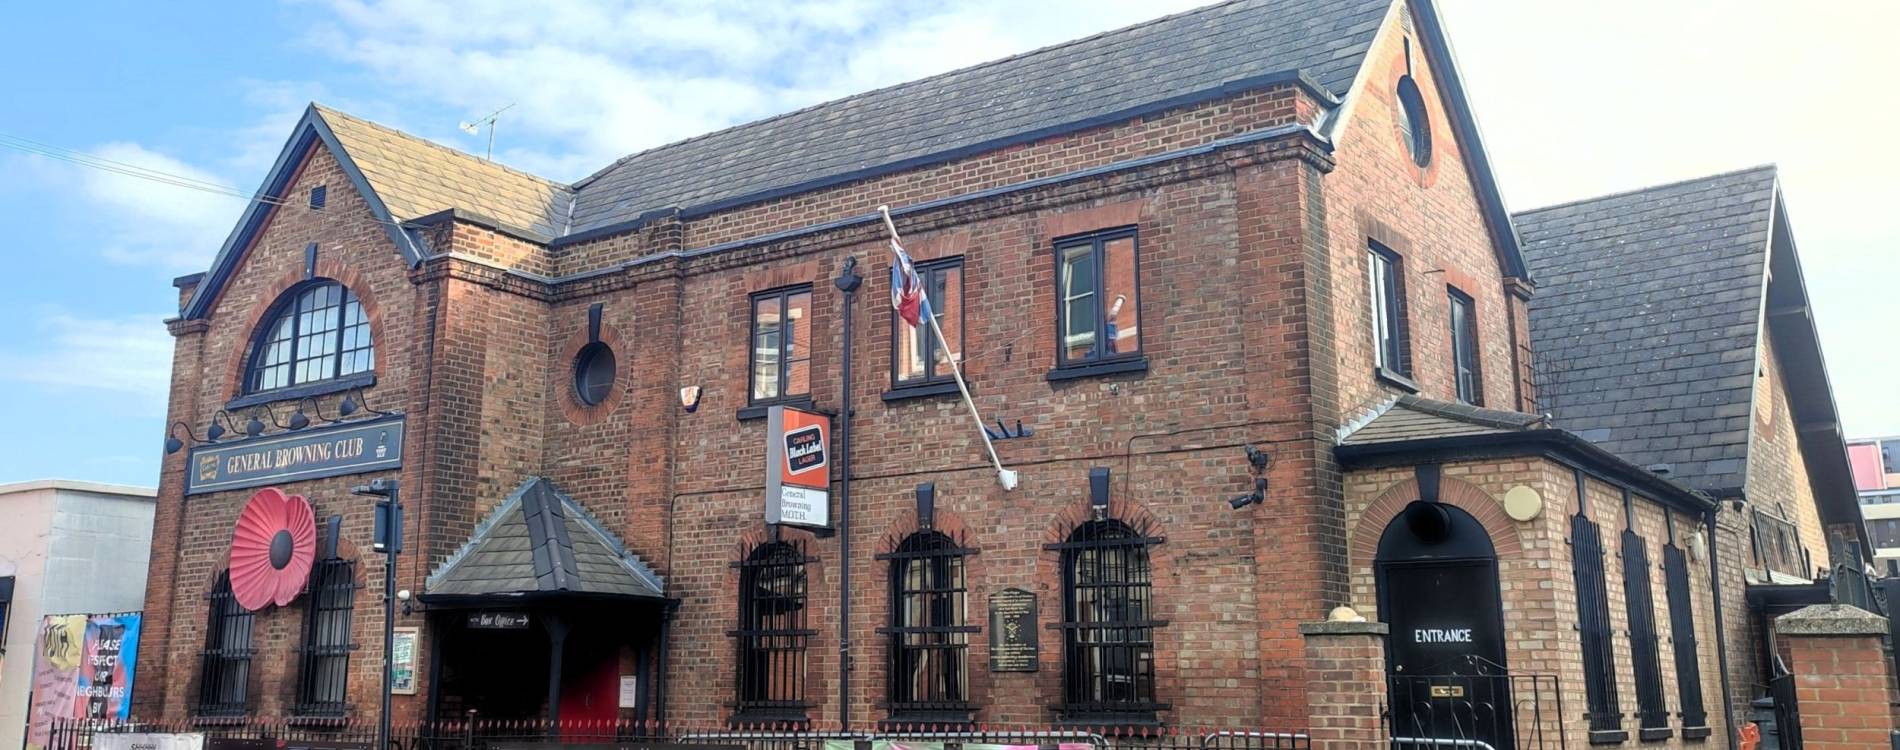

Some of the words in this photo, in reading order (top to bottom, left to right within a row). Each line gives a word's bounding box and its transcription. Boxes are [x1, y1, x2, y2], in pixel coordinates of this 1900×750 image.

[227, 452, 272, 474] GENERAL
[275, 442, 331, 467] BROWNING
[335, 438, 364, 459] CLUB
[798, 454, 816, 465] LAGER
[782, 488, 806, 499] General
[781, 499, 812, 513] Browning
[495, 614, 516, 628] Office
[1415, 629, 1472, 643] ENTRANCE
